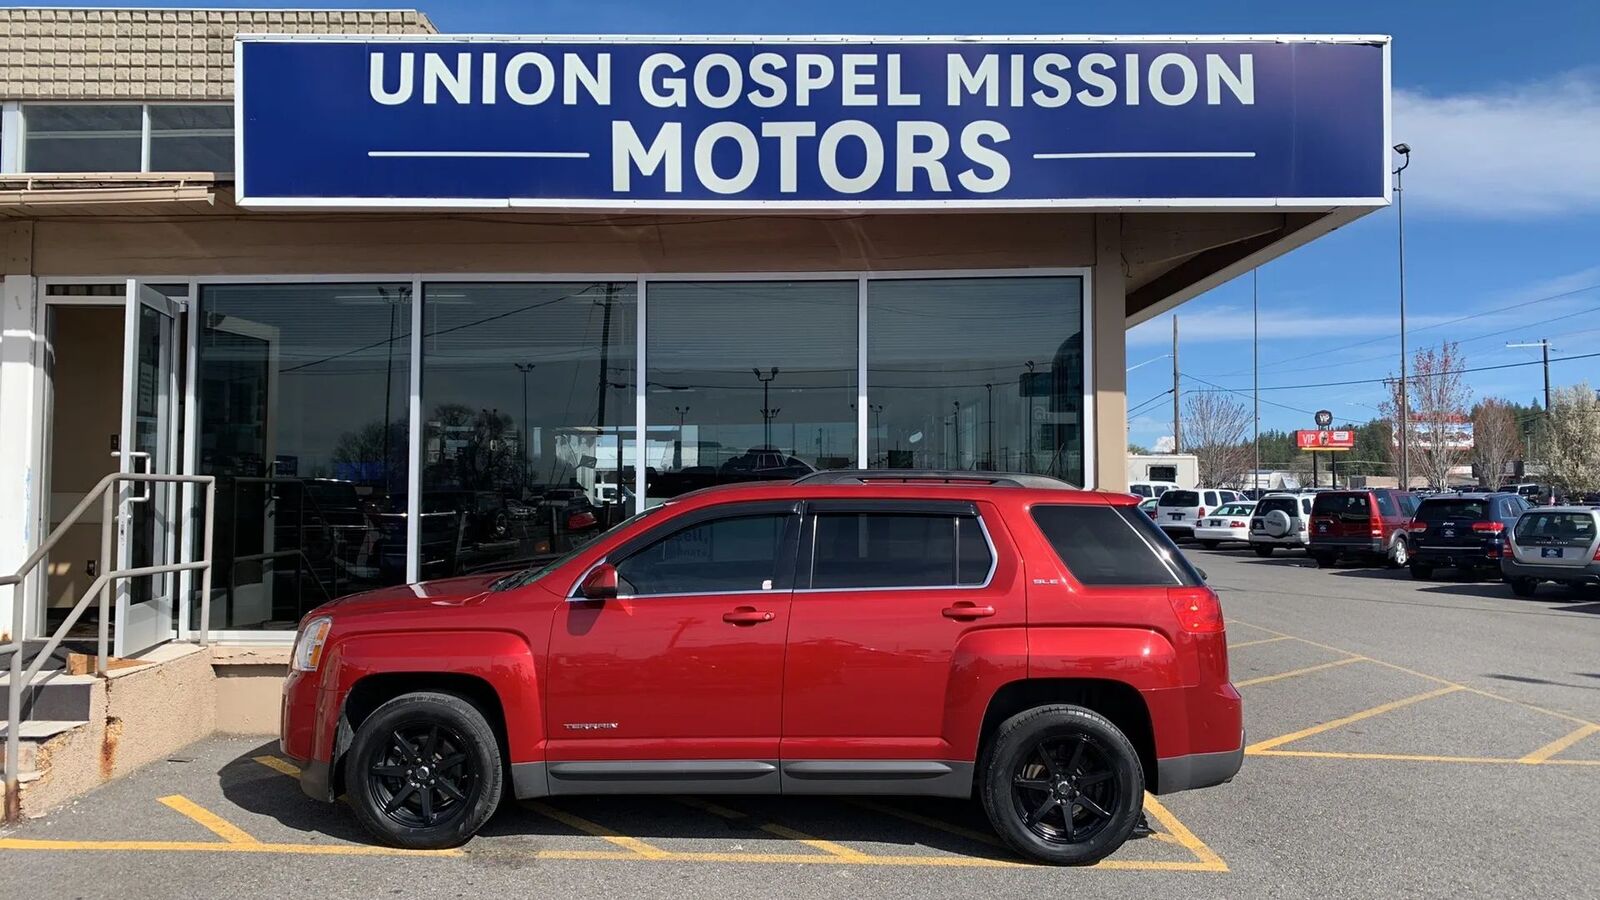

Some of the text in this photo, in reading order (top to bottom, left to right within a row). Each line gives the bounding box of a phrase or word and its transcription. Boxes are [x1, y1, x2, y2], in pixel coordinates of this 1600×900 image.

[369, 51, 1255, 109] UNION GOSPEL MISSION
[612, 119, 1011, 195] MOTORS
[1319, 413, 1330, 423] VIP
[1302, 433, 1316, 444] VIP
[563, 722, 619, 730] TERRAIN
